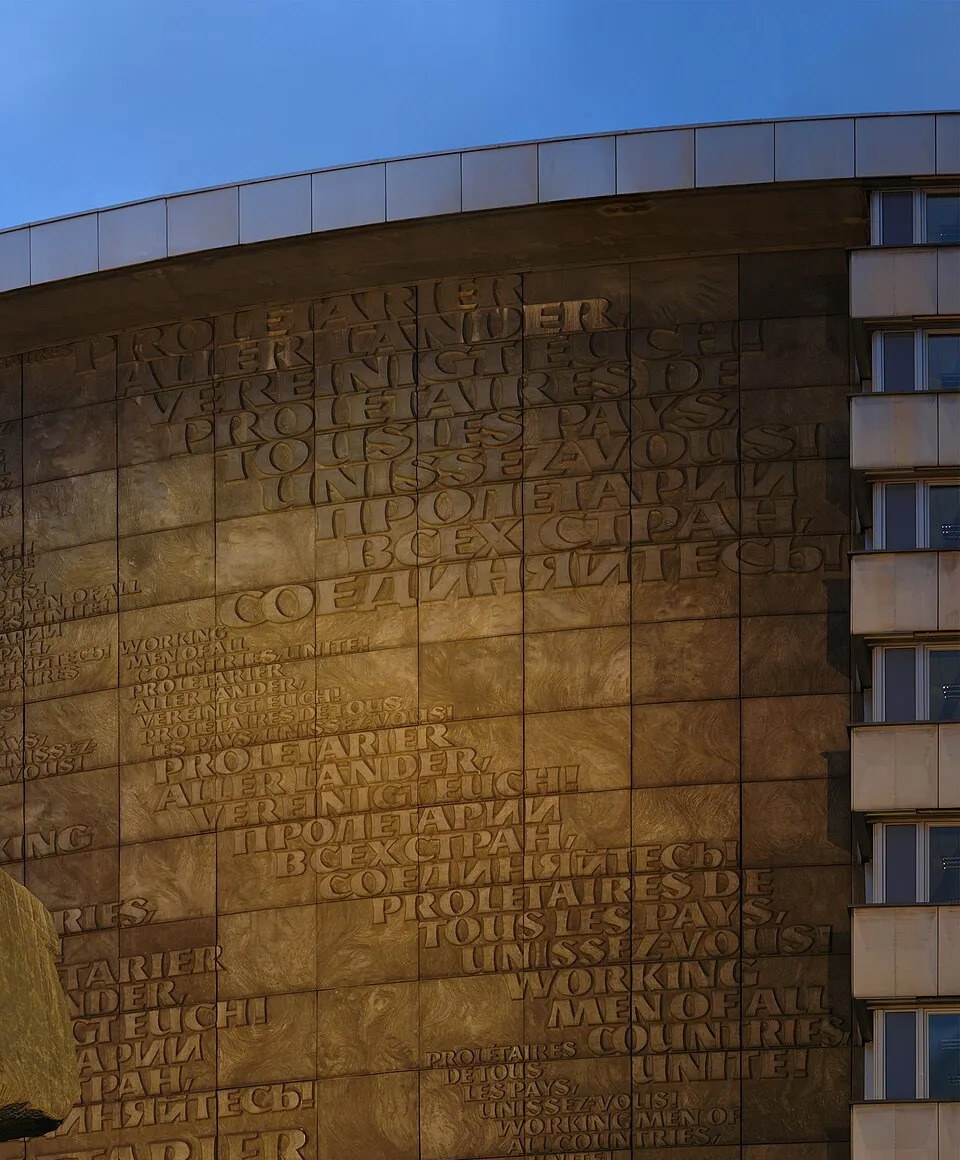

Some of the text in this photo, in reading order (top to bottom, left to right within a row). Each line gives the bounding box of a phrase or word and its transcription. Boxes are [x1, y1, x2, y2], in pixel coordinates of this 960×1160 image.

[75, 274, 523, 375] PROLETARIER
[118, 333, 314, 400] ALLER
[136, 321, 764, 425] VEREINIGT EUCH!
[171, 356, 740, 456] PROLETAIRES DE
[217, 421, 418, 485] TOUS
[420, 406, 524, 452] LES
[318, 459, 798, 539] ПРОЛЕТАРИИ
[339, 499, 811, 573] ВСЕХ СТРАН,
[10, 554, 35, 570] DE
[12, 595, 62, 613] MEN
[73, 587, 103, 603] OF
[106, 579, 140, 597] ALL
[121, 625, 229, 655] WORKING
[127, 637, 246, 670] MEN OF ALL
[287, 636, 371, 658] UNITE!
[131, 663, 285, 698] PROLETARIER
[131, 690, 201, 714] ALLER
[139, 687, 341, 728] VEREINIGT EUCH!
[143, 711, 295, 744] PROLETAIRES
[297, 705, 329, 720] DE
[145, 740, 187, 756] LES
[153, 723, 453, 785] PROLETARIER
[156, 766, 286, 812] ALLER
[192, 764, 581, 828] VEREINIGT EUCH!
[235, 795, 564, 855] ПРОЛЕТАРИИ
[276, 824, 577, 878] ВСЕХ СТРАН,
[318, 838, 738, 899] СОЕДИНЯЙТЕСЬ!
[372, 867, 773, 924] PROLETAIRES DE
[418, 897, 786, 949] TOUS LES PAYS,
[508, 959, 760, 1000] WORKING
[124, 997, 267, 1038] EUCH!
[548, 986, 829, 1030] MEN OF ALL
[443, 1066, 475, 1087] DE
[632, 1049, 810, 1085] UNITE!
[464, 1078, 579, 1103] LES PAYS,
[498, 1107, 740, 1138] WORKING MEN OF
[506, 1125, 719, 1154] ALL COUNTRIES,
